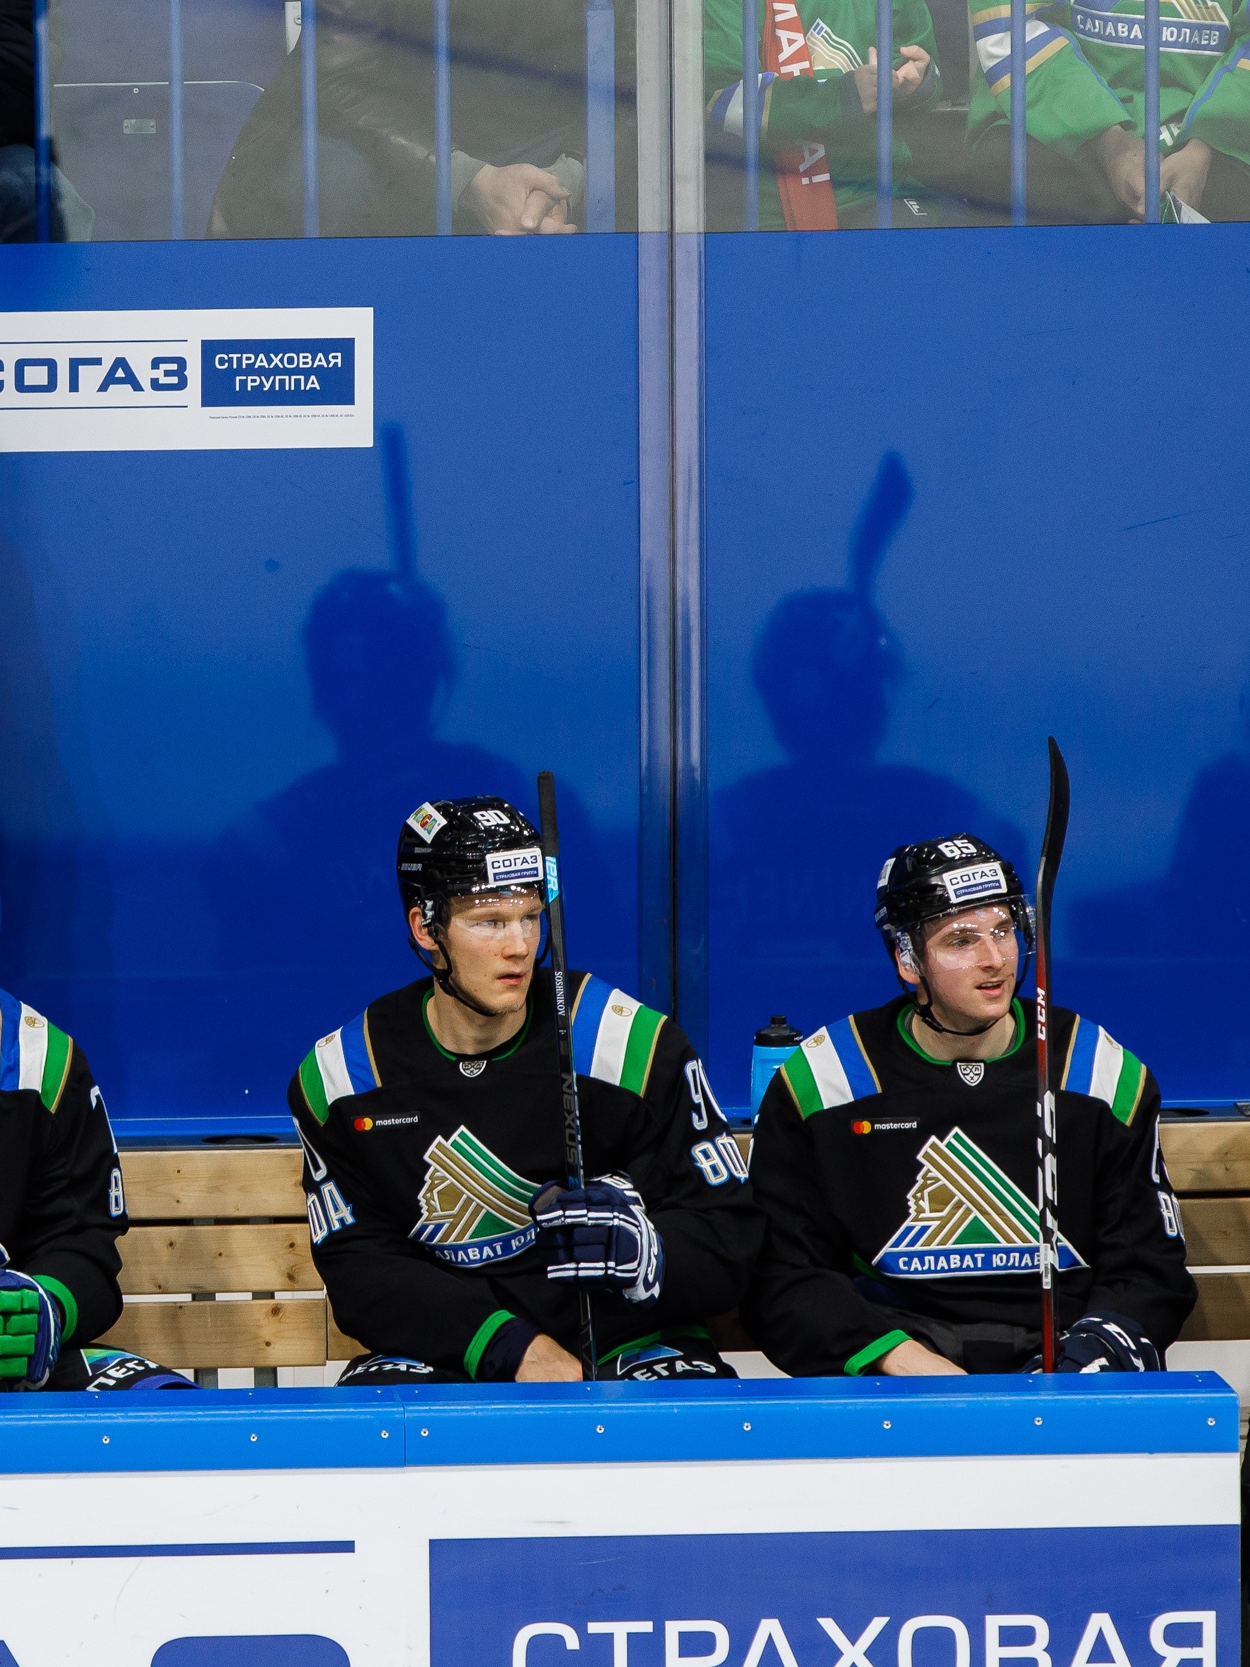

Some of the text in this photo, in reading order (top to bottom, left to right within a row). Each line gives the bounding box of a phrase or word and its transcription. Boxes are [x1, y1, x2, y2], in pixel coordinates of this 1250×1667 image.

[1077, 14, 1220, 46] САЛАВА ЮЛАЕВ
[214, 352, 342, 369] СТРАХОВАЯ
[235, 374, 321, 392] ГРУППА
[473, 810, 511, 827] 90
[938, 839, 978, 859] 65
[491, 854, 538, 870] СОГАЗ
[950, 868, 999, 886] СОГАЗ
[554, 971, 566, 1017] SOSHNIKOV
[1036, 987, 1048, 1041] CCM
[375, 1115, 419, 1127] mastercard
[561, 1072, 579, 1165] NEXUS
[873, 1120, 917, 1130] mastercard
[434, 1242, 504, 1263] АЛАВАТ
[898, 1252, 1041, 1272] САЛАВАТ ЮЛАЕ
[625, 1360, 717, 1381] ЕГАЗ
[513, 1610, 1217, 1667] СТРАХОВАЯ
